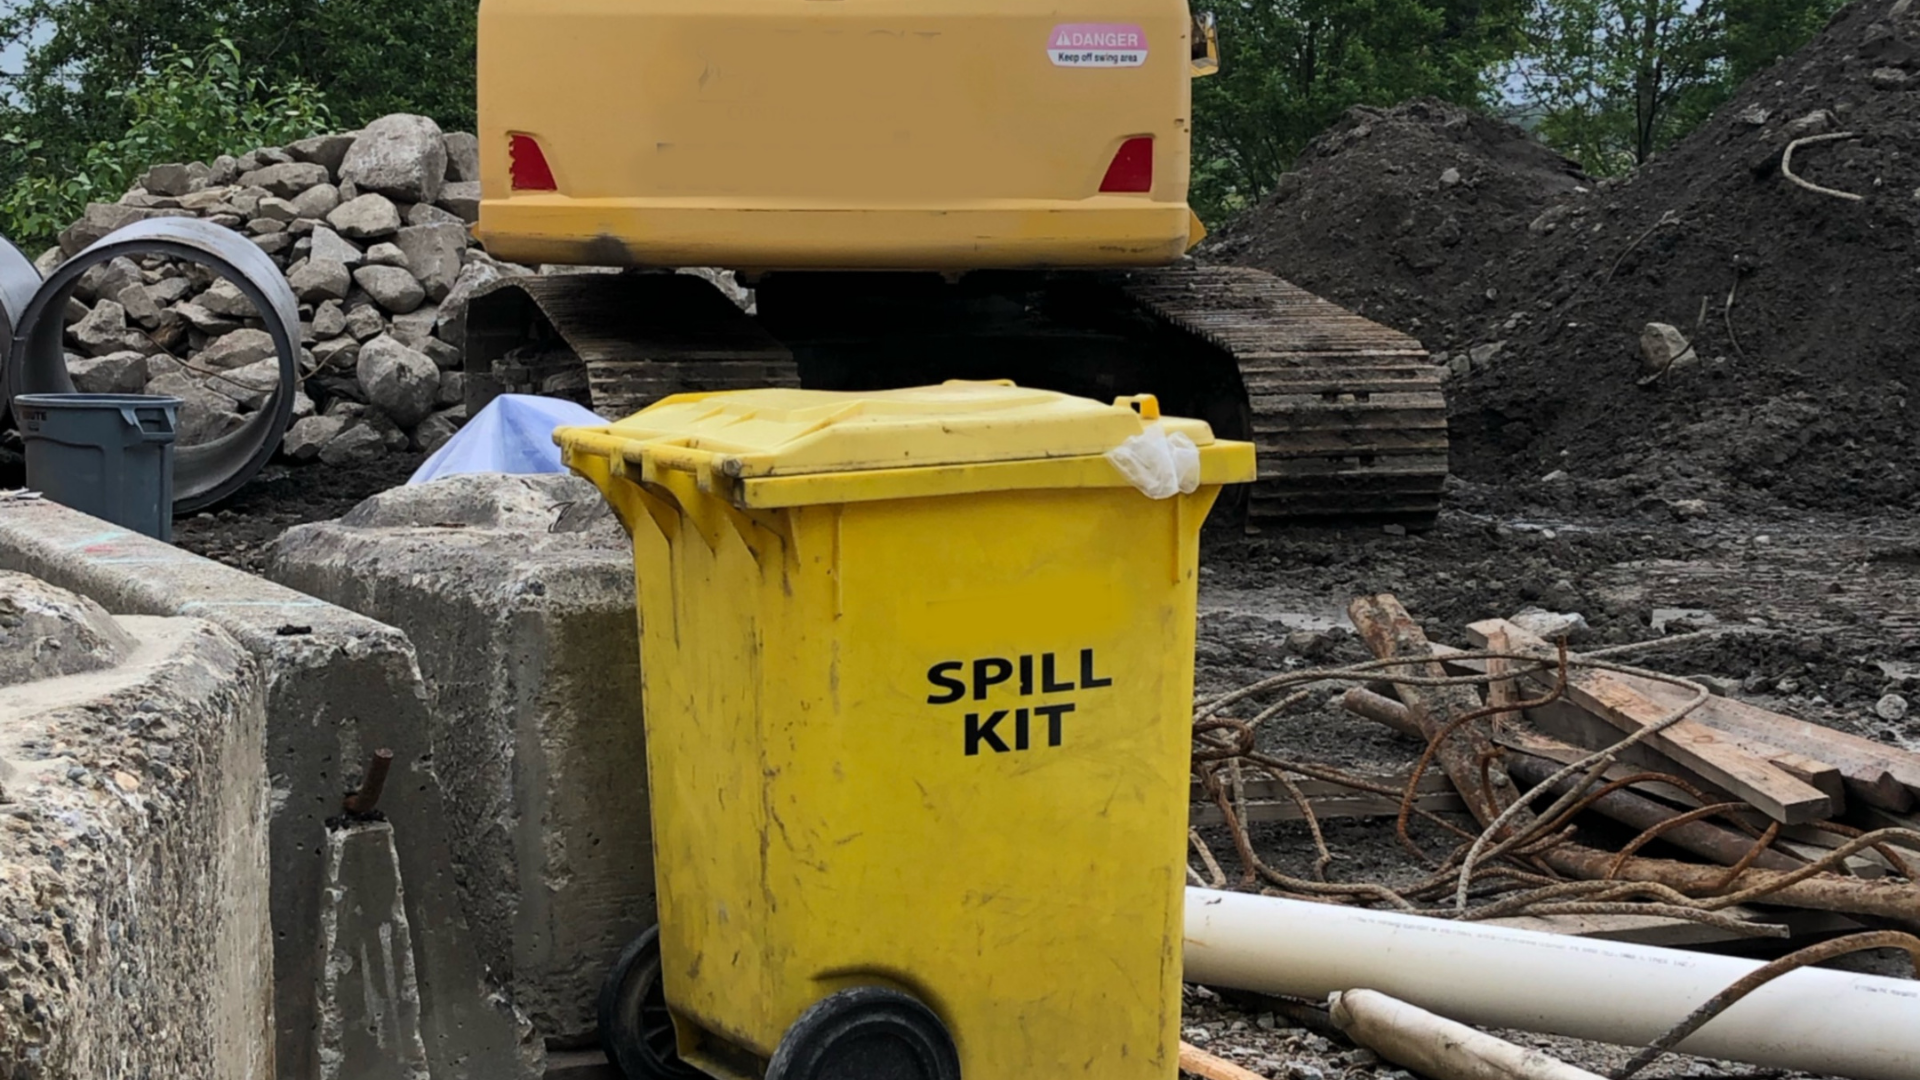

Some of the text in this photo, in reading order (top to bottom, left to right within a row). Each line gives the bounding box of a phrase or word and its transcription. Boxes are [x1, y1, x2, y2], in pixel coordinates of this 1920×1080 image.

[1072, 32, 1138, 47] DANGER
[1058, 52, 1137, 65] Keep off swing area
[927, 648, 1112, 705] SPILL
[964, 702, 1075, 756] KIT
